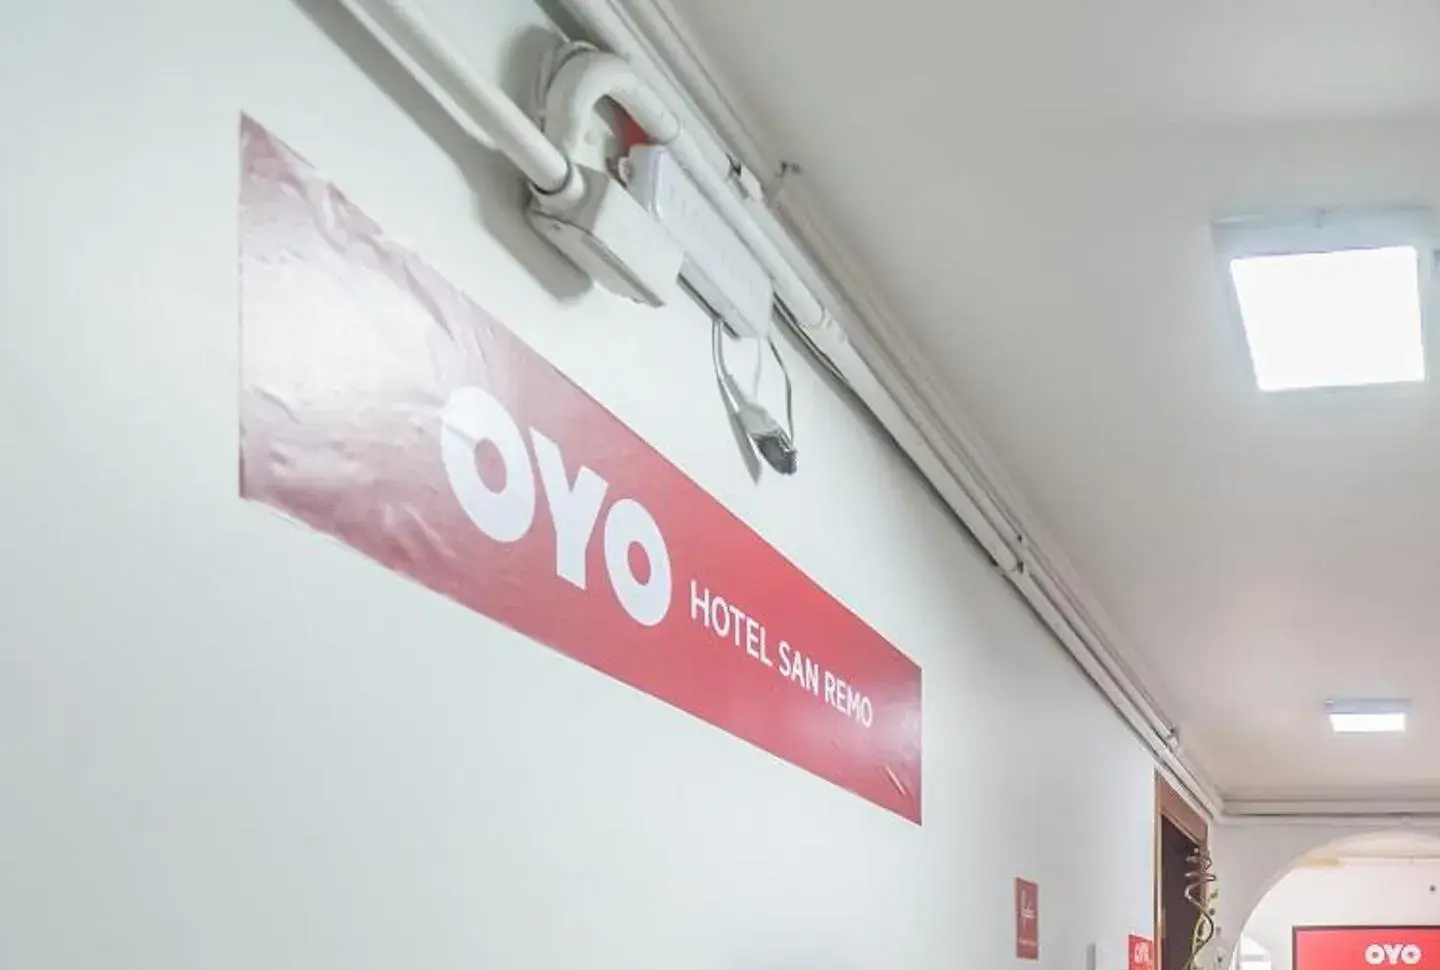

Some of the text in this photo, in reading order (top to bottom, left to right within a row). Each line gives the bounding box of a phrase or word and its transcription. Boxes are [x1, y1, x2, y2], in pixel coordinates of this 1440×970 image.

[440, 386, 672, 626] OYO
[690, 579, 873, 728] HOTEL SAN REMO
[1364, 944, 1422, 965] OYO
